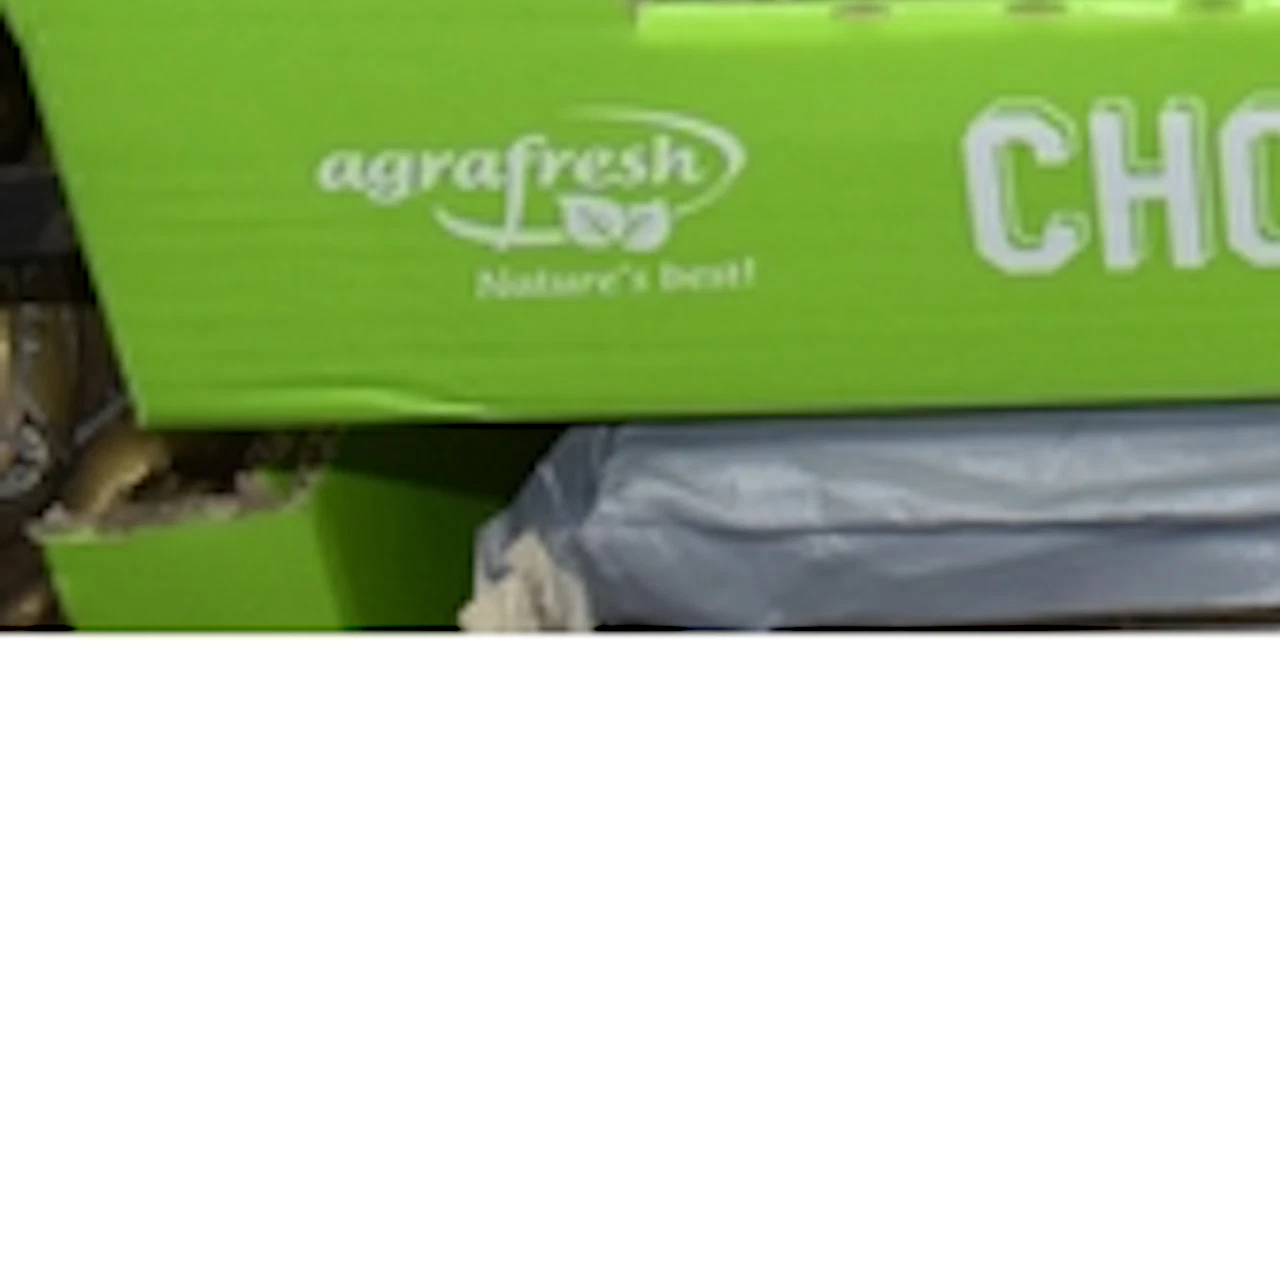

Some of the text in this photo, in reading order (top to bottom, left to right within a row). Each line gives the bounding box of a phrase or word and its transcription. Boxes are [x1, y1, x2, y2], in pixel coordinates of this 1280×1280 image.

[316, 132, 706, 246] agrafresh
[473, 255, 756, 301] Nature's best!
